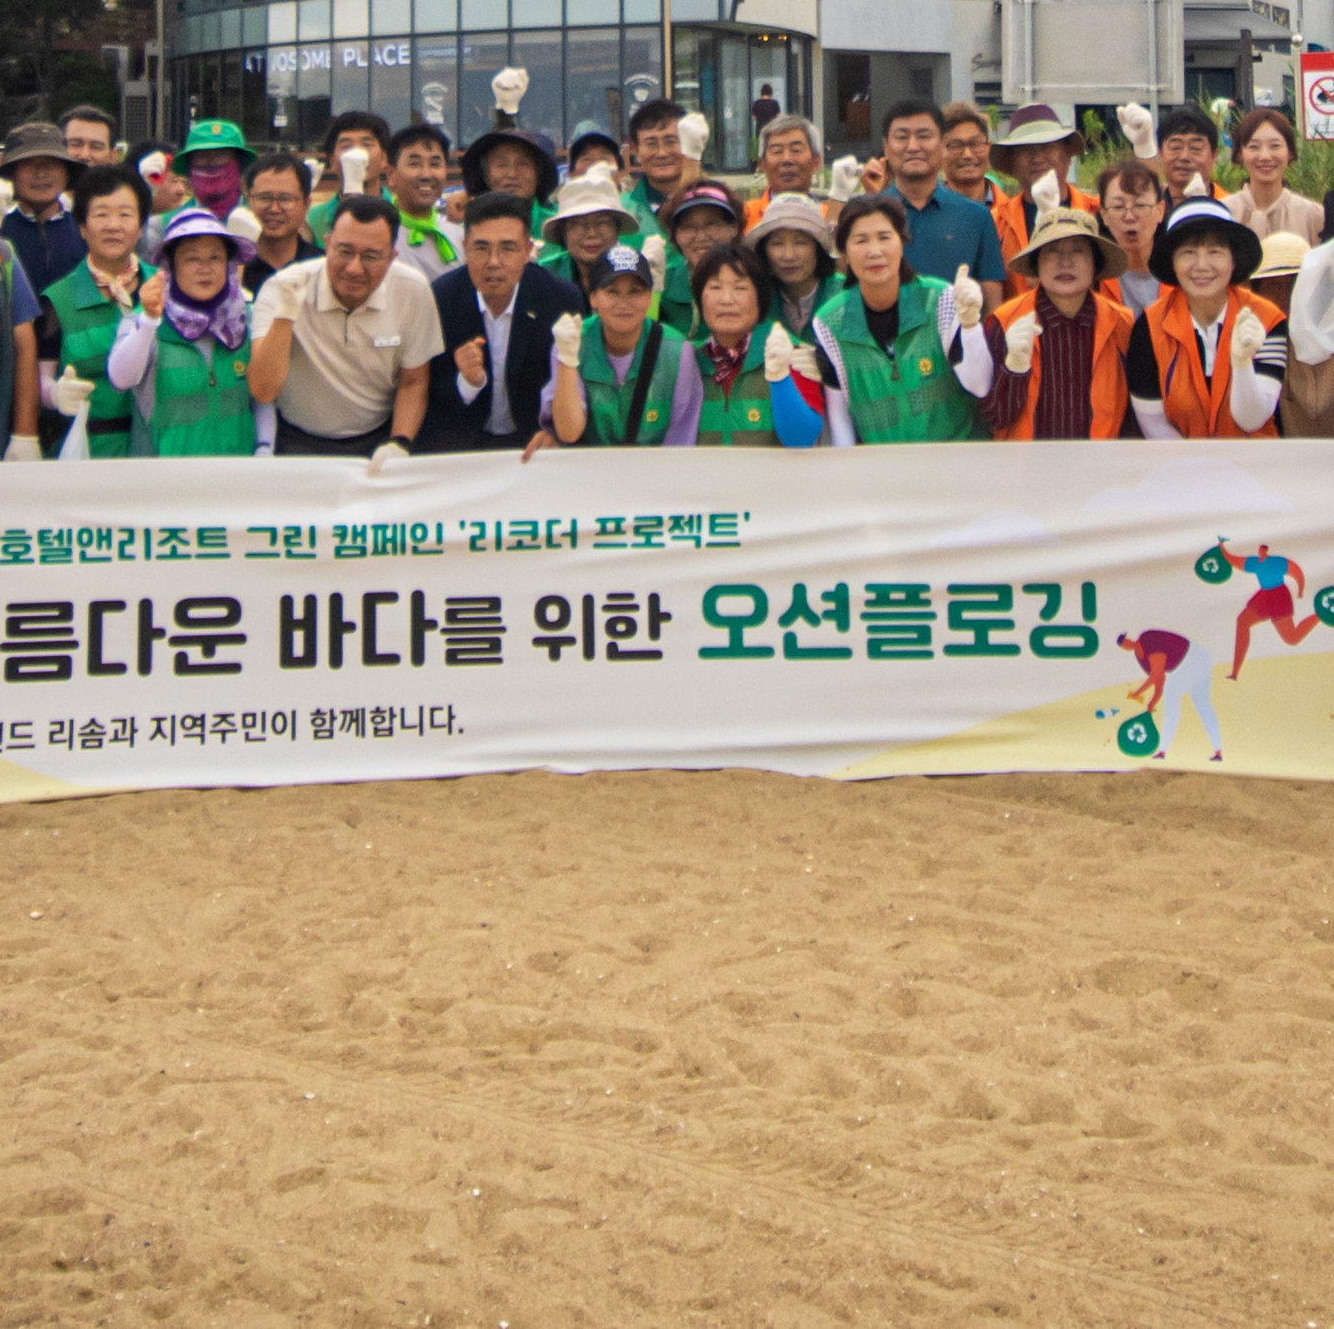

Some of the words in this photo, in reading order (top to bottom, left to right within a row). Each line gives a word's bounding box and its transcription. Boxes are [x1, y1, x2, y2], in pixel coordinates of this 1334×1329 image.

[244, 525, 318, 561] 그린
[331, 521, 445, 559] 캠페인
[458, 517, 578, 552] '리코더
[592, 511, 751, 550] 프로젝트'
[278, 589, 507, 670] 바다를
[531, 591, 673, 662] 위한
[697, 580, 1100, 661] 오션플로깅
[48, 715, 139, 751] 리솜과
[148, 708, 298, 746] 지역주민이
[309, 704, 466, 739] 함께합니다.
